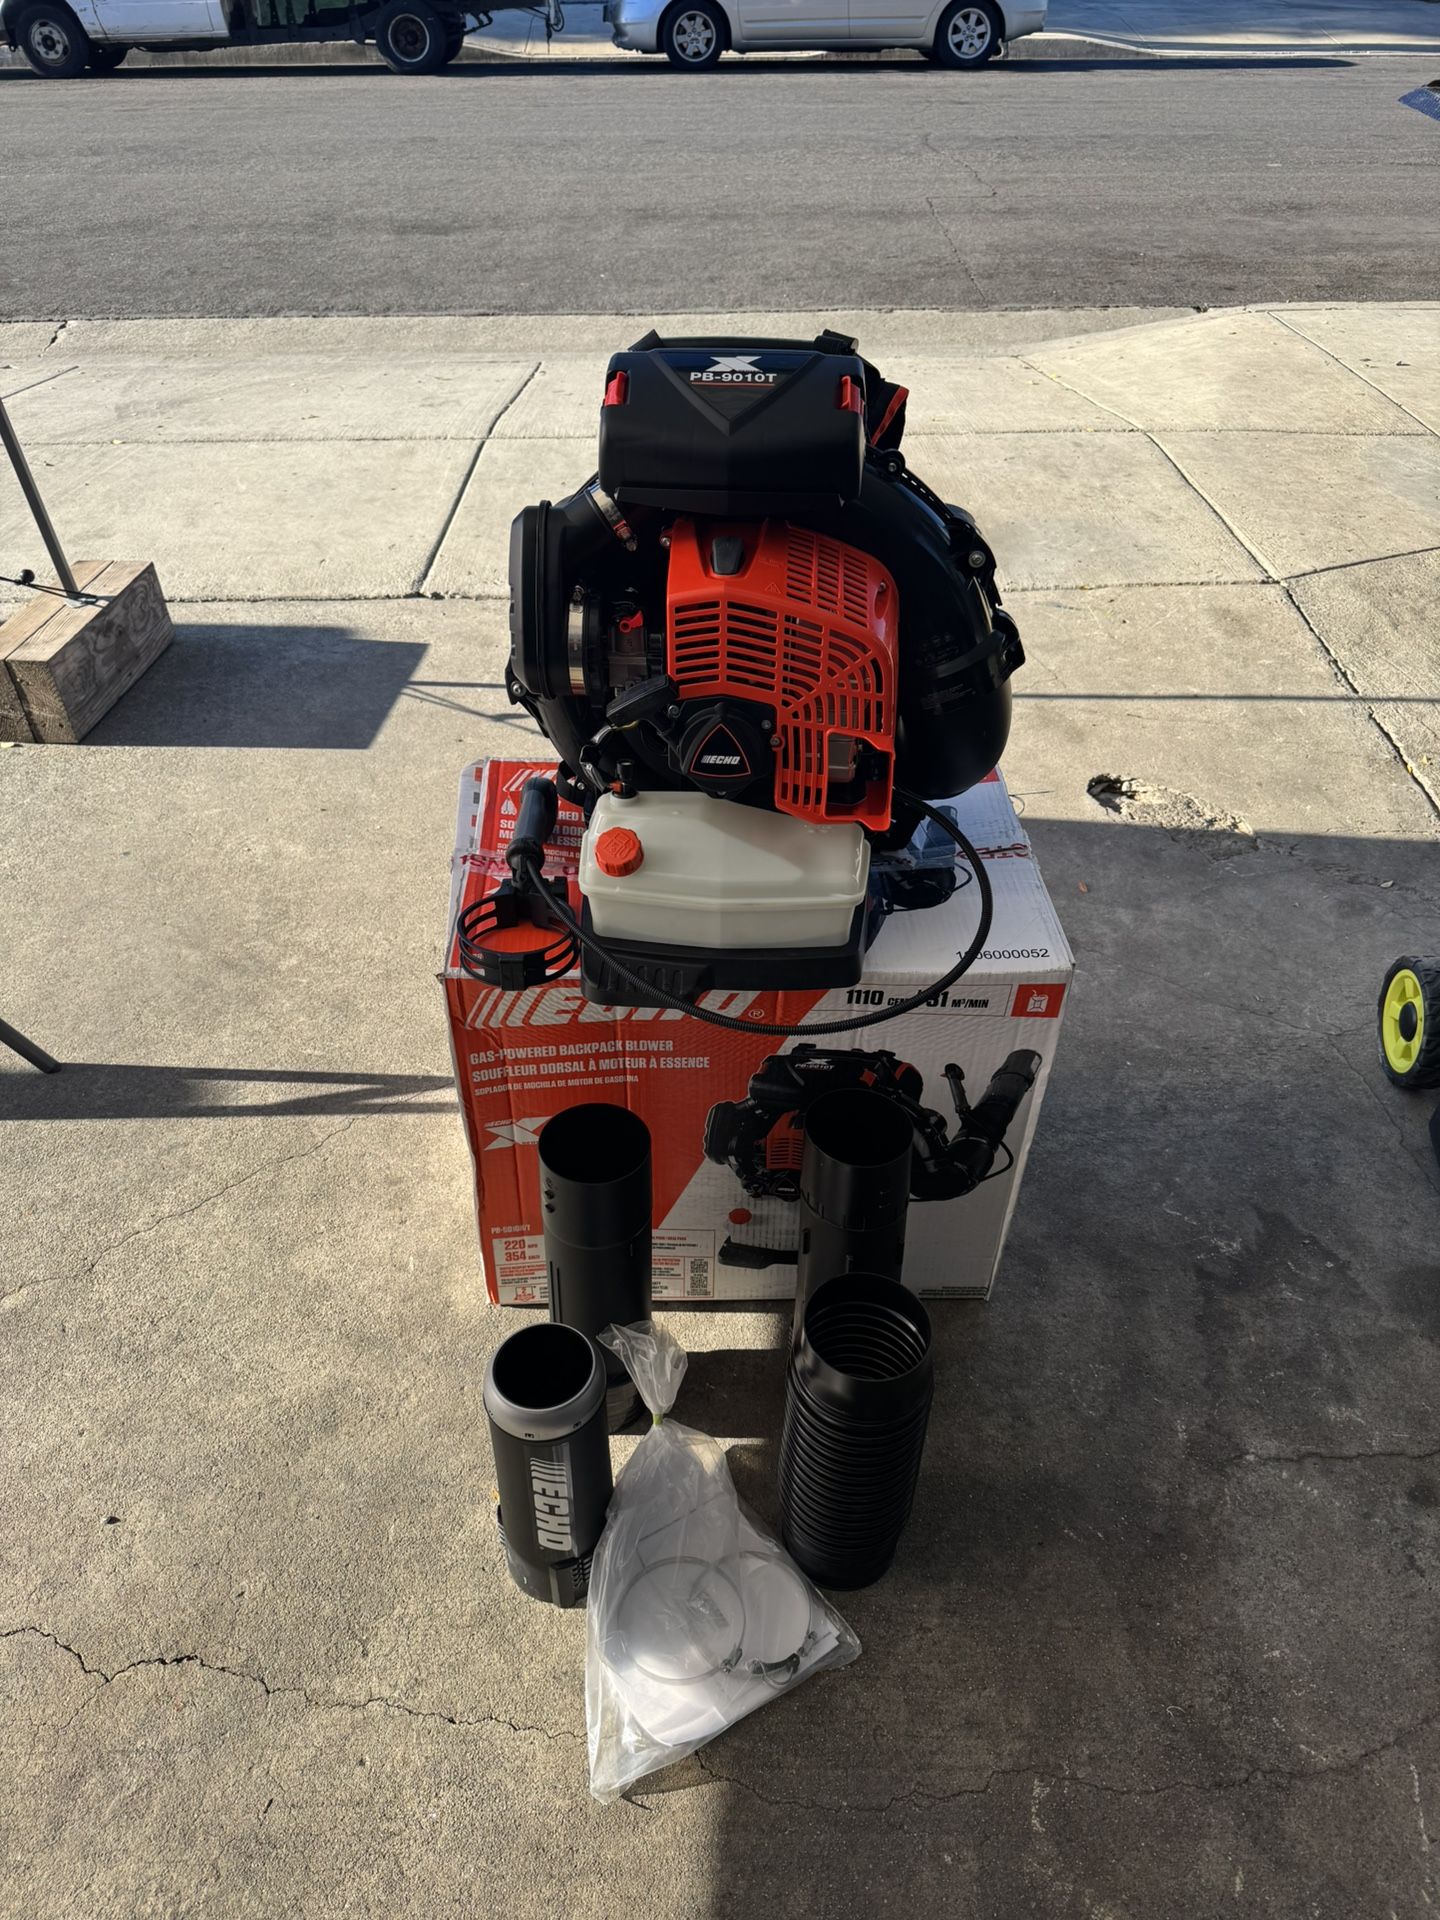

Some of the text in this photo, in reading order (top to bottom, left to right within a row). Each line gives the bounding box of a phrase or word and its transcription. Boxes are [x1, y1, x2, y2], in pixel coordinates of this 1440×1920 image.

[690, 372, 777, 382] PB-9010T
[708, 755, 741, 765] ECHO
[956, 949, 1050, 960] 106000052
[846, 990, 885, 1006] 1110
[470, 1040, 673, 1065] GAS-POWERED BACKPACK BLOWER
[472, 1065, 538, 1082] SOUFFLEUR
[540, 1061, 586, 1075] DORSAL
[599, 1058, 647, 1071] MOTEUR
[660, 1057, 710, 1068] ESSENCE
[523, 1080, 556, 1090] MOCHILA
[568, 1077, 593, 1086] MOTOR
[504, 1239, 526, 1251] 220
[505, 1250, 527, 1262] 354
[532, 1477, 572, 1551] ECHO
